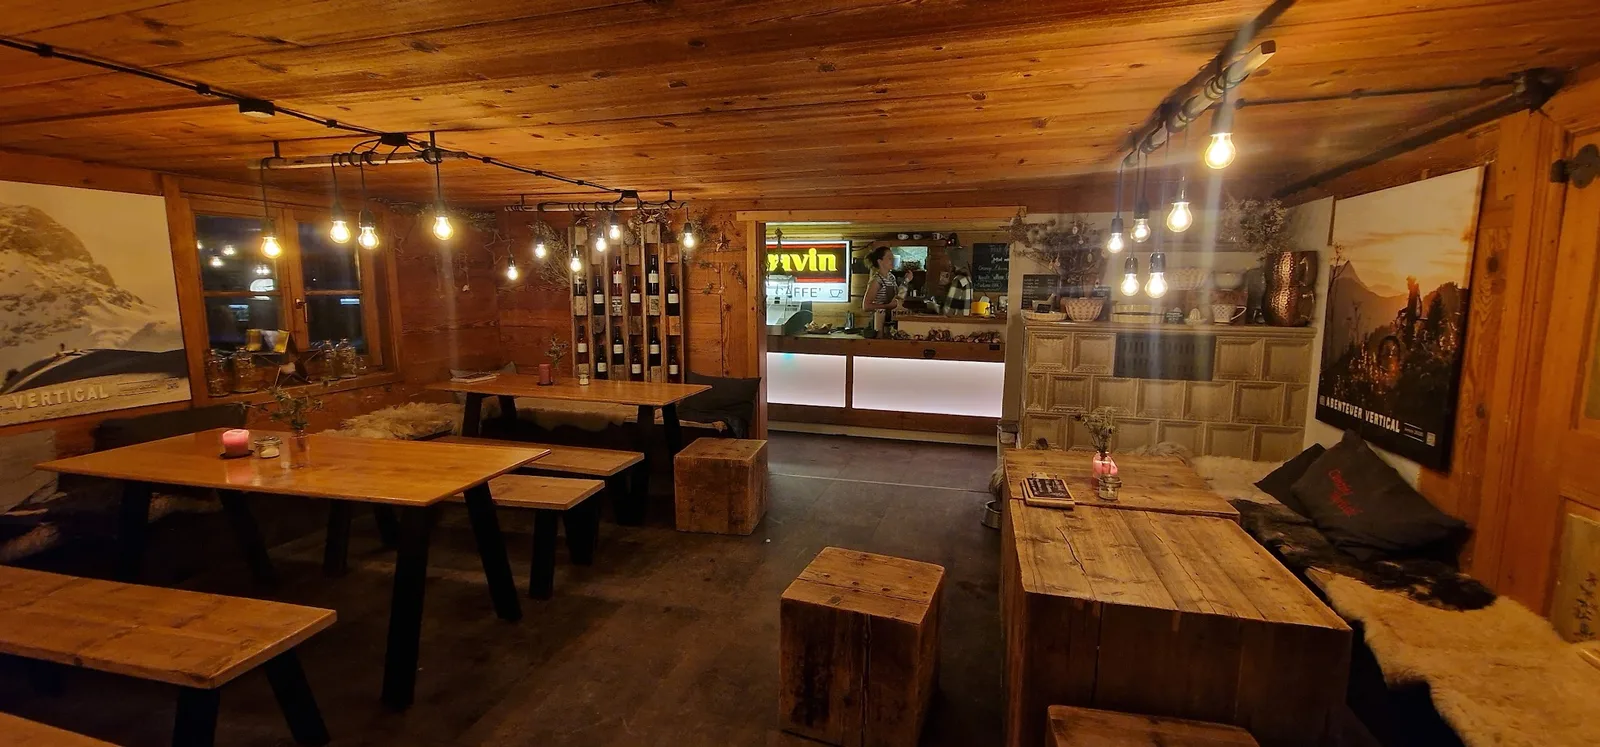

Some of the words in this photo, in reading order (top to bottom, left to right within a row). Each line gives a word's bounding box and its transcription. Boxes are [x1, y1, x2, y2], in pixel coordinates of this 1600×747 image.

[12, 385, 110, 410] VERTICAL
[1325, 396, 1363, 420] ABENTEUER
[1365, 409, 1401, 433] VERTICAL
